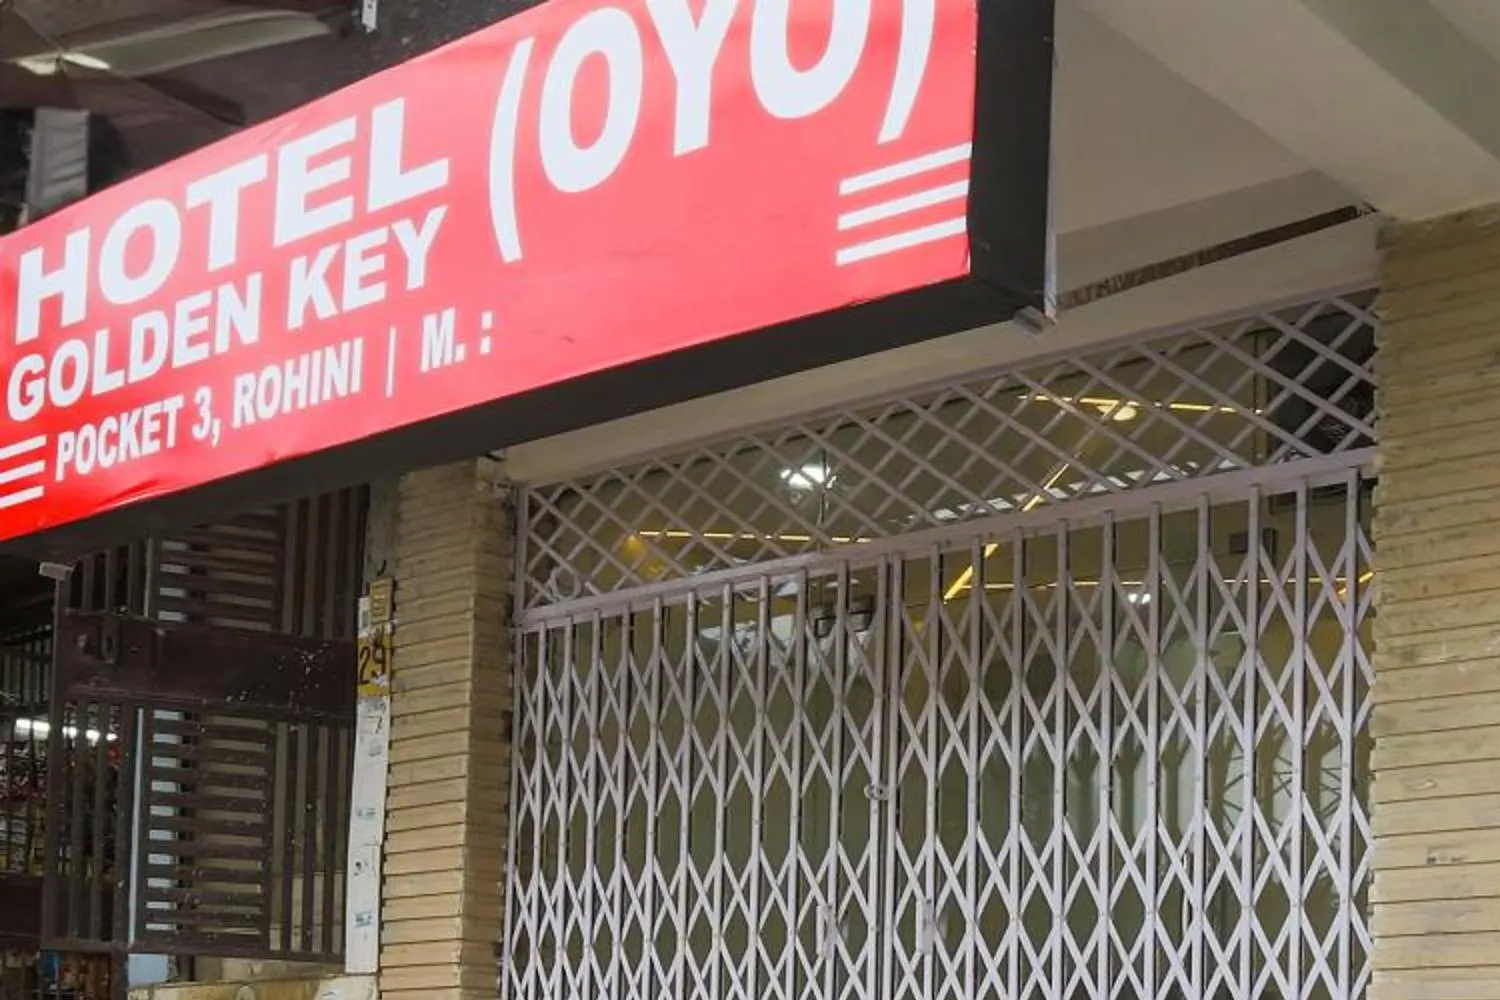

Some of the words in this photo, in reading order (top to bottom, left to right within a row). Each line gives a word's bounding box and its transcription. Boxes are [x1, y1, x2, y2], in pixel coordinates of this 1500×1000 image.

[7, 273, 264, 422] GOLDEN
[287, 205, 449, 331] KEY
[13, 97, 449, 344] HOTEL
[55, 394, 184, 482] POCKET
[191, 385, 222, 448] 3,
[232, 337, 364, 430] ROHINI
